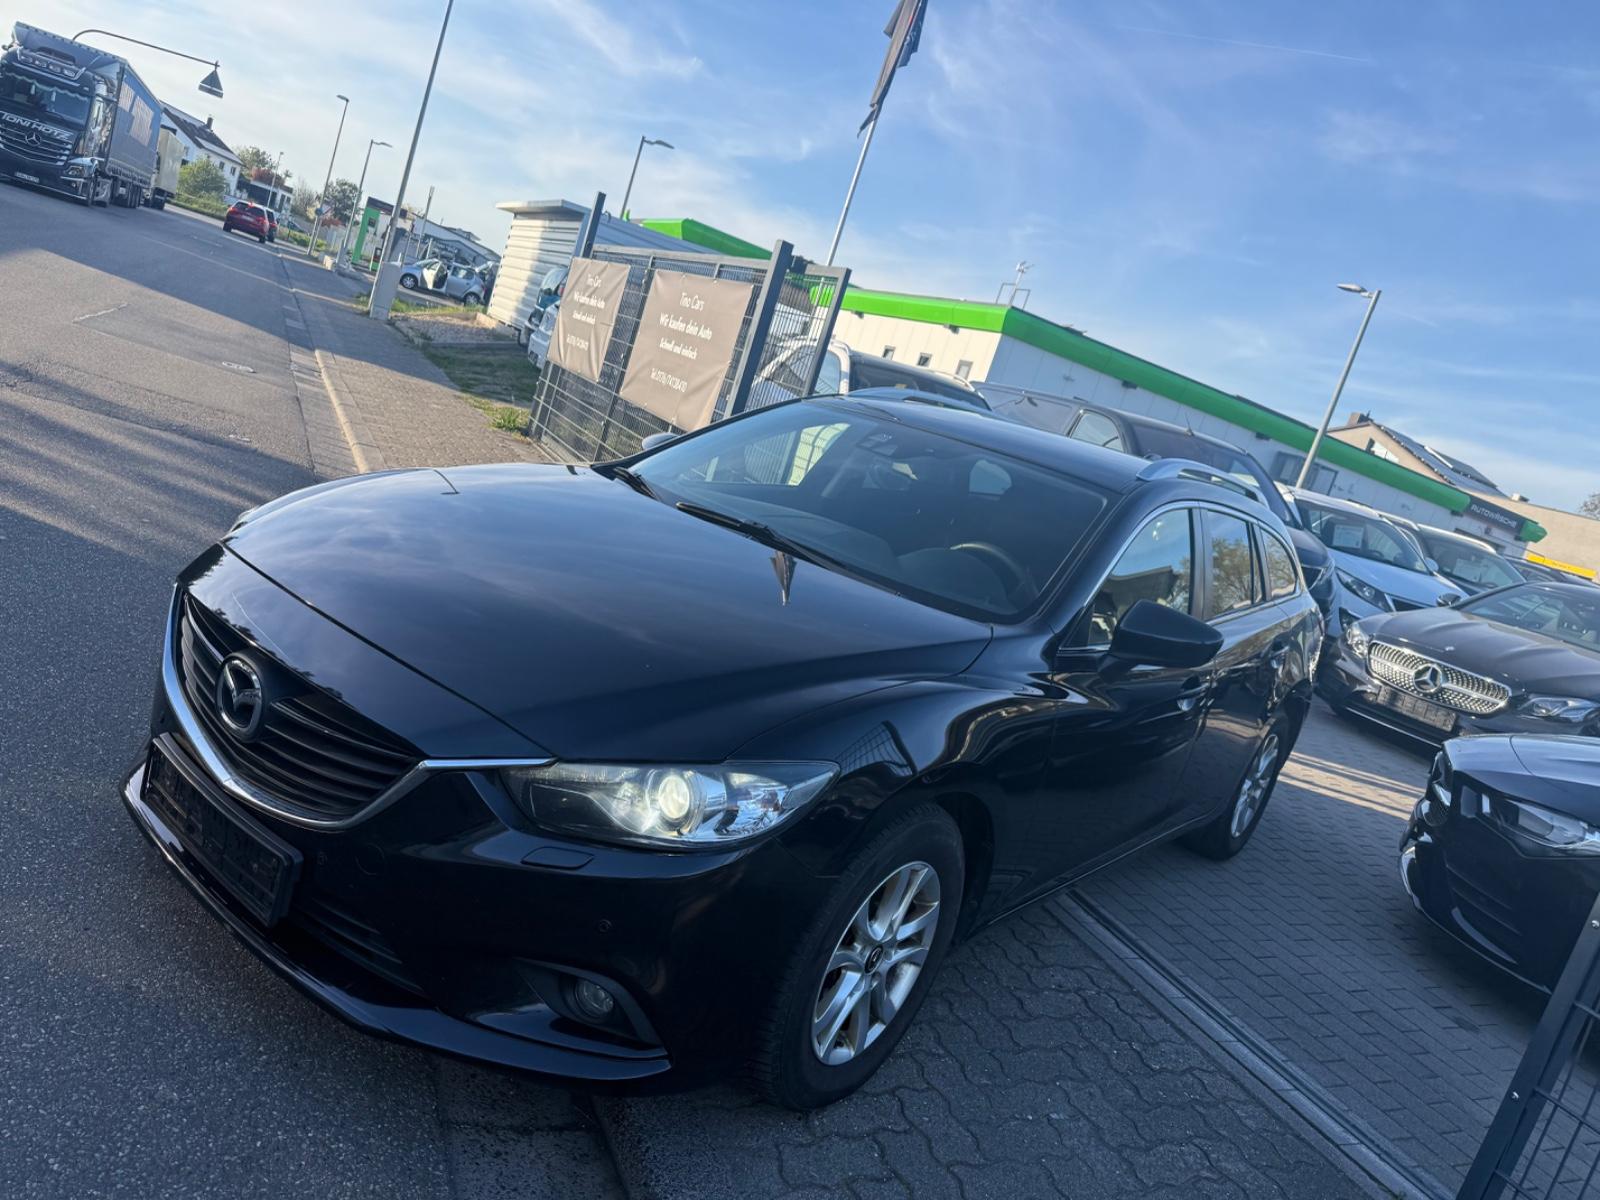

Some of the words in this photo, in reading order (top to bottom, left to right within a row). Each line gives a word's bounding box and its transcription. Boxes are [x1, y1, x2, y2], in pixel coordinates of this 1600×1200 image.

[2, 112, 31, 127] TONI
[680, 292, 691, 308] Tino
[691, 295, 704, 311] Cars
[659, 312, 669, 327] Wir
[668, 314, 686, 332] kaufen
[685, 320, 698, 336] dein
[697, 324, 712, 340] Auto
[673, 343, 682, 354] und
[681, 345, 697, 360] einfach
